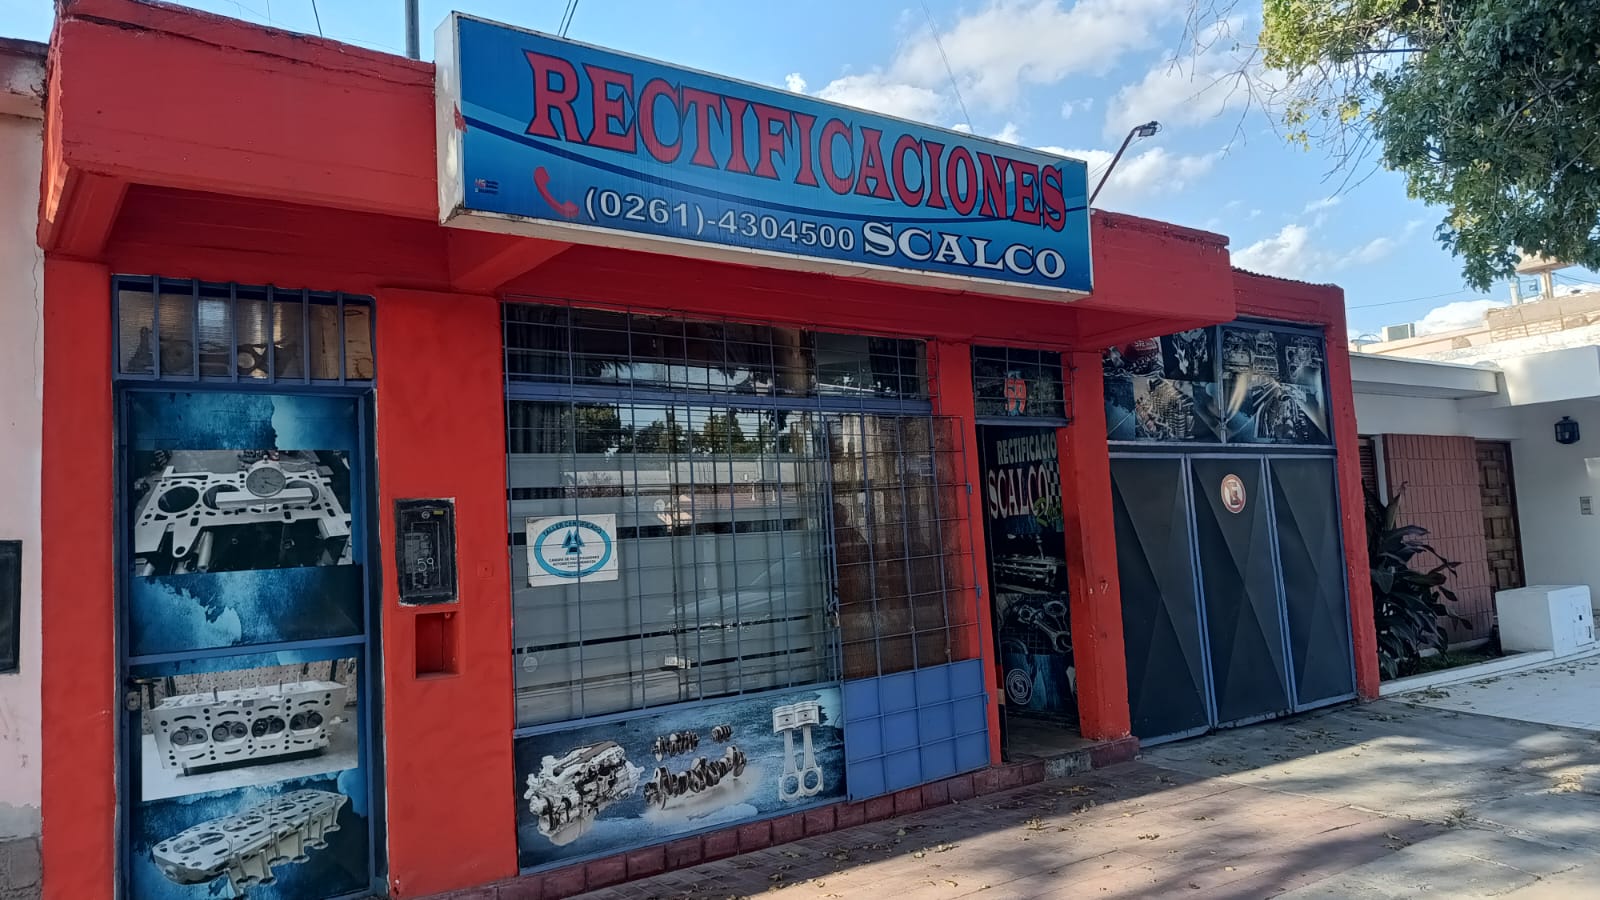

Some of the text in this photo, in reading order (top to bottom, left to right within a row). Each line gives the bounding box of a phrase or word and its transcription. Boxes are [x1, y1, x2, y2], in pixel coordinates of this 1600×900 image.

[523, 50, 1066, 233] RECTIFICACIONES
[585, 187, 854, 251] (0261)-4304500
[863, 222, 1066, 280] SCALCO
[1004, 379, 1027, 414] 59
[988, 464, 1049, 518] SCALCO
[564, 521, 602, 533] CERIFICADO
[418, 558, 435, 572] 59
